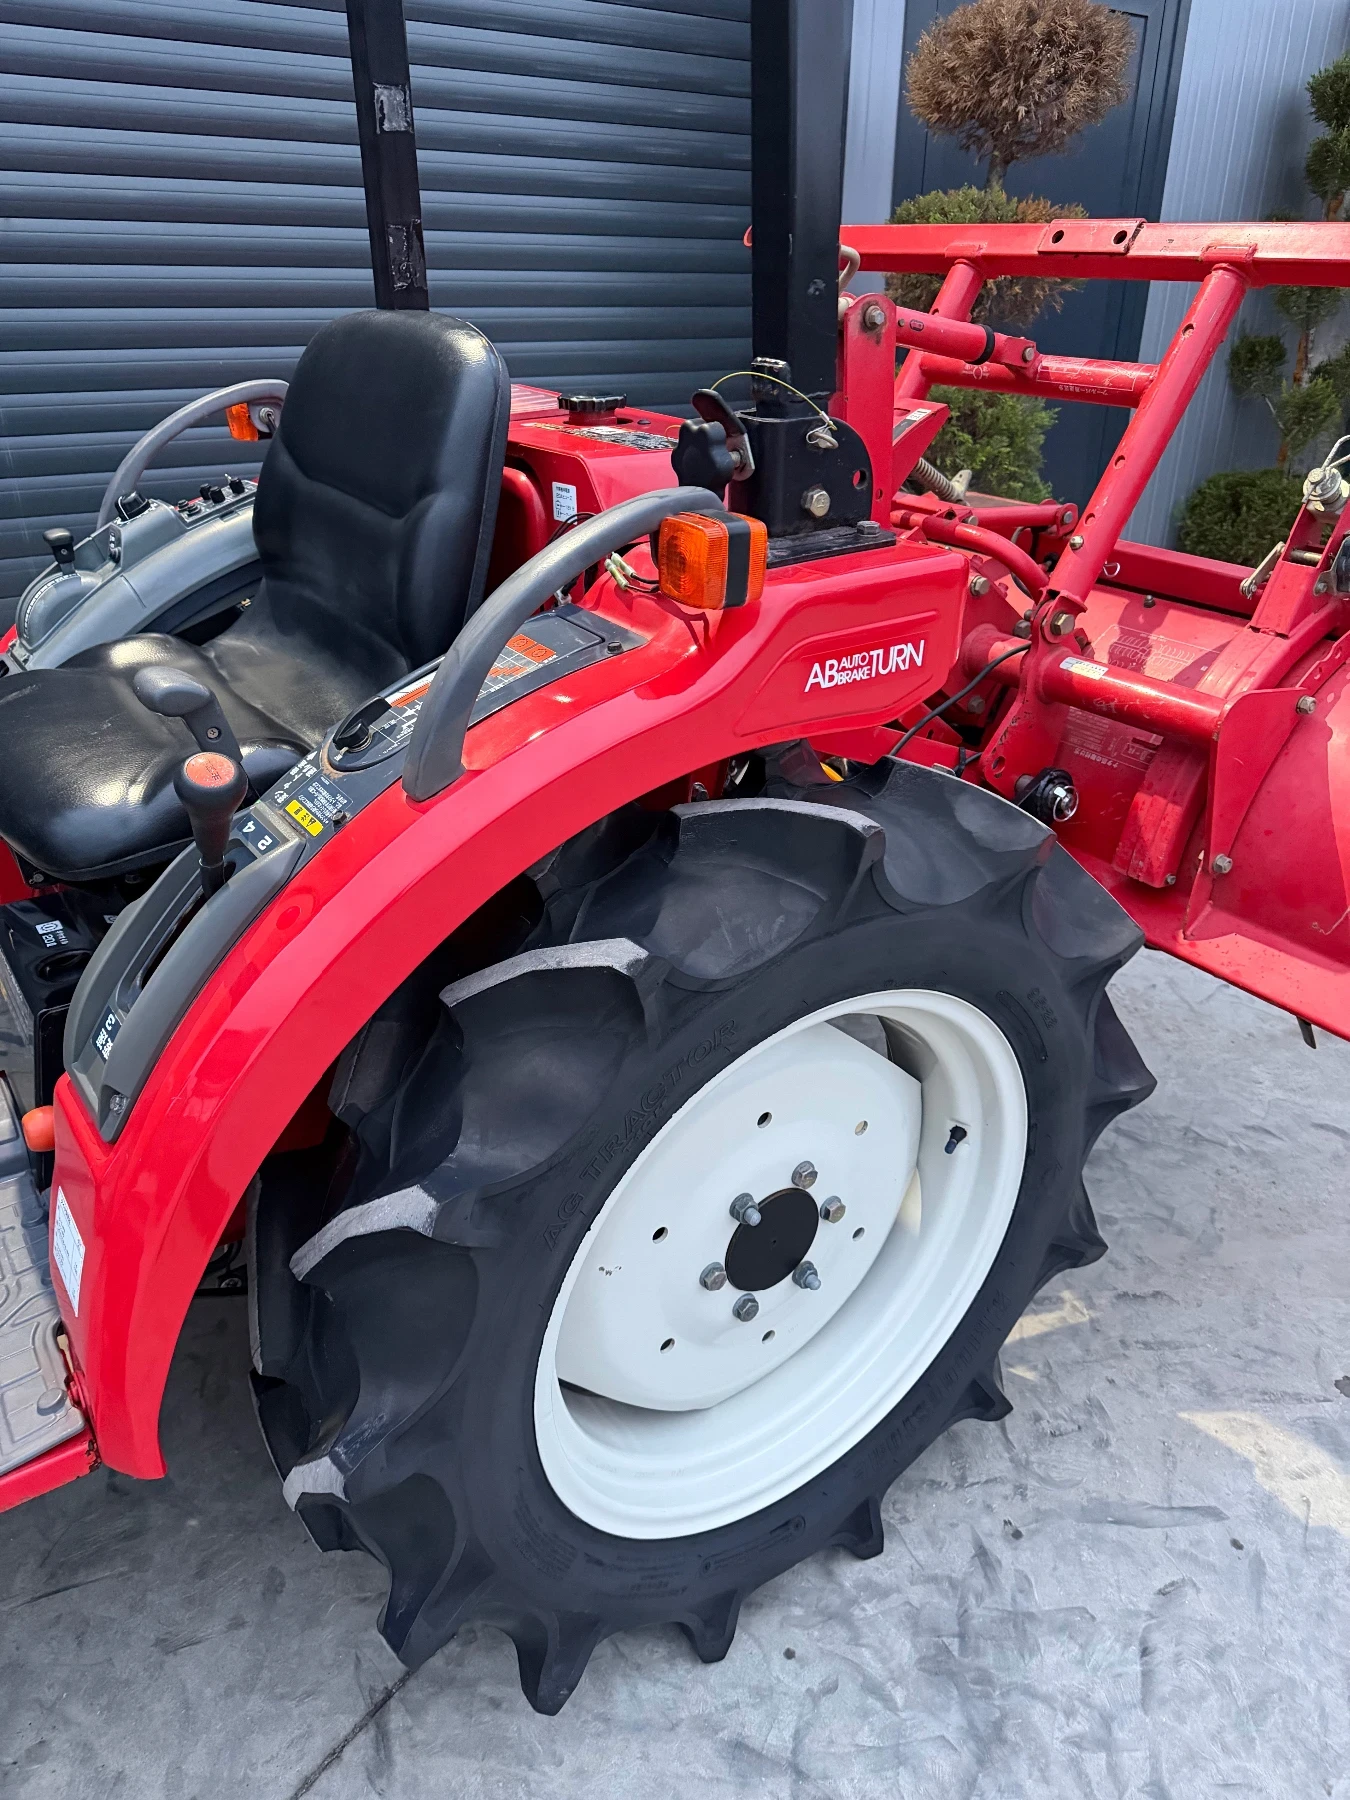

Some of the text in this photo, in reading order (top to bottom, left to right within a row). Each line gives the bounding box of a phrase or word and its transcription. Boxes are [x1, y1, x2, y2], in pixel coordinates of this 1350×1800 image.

[804, 639, 925, 693] AB AUTO BRAKE TURN
[242, 820, 273, 851] 2 4
[106, 1013, 116, 1031] 3
[543, 1191, 585, 1252] AG
[580, 1019, 737, 1182] TRACTOR
